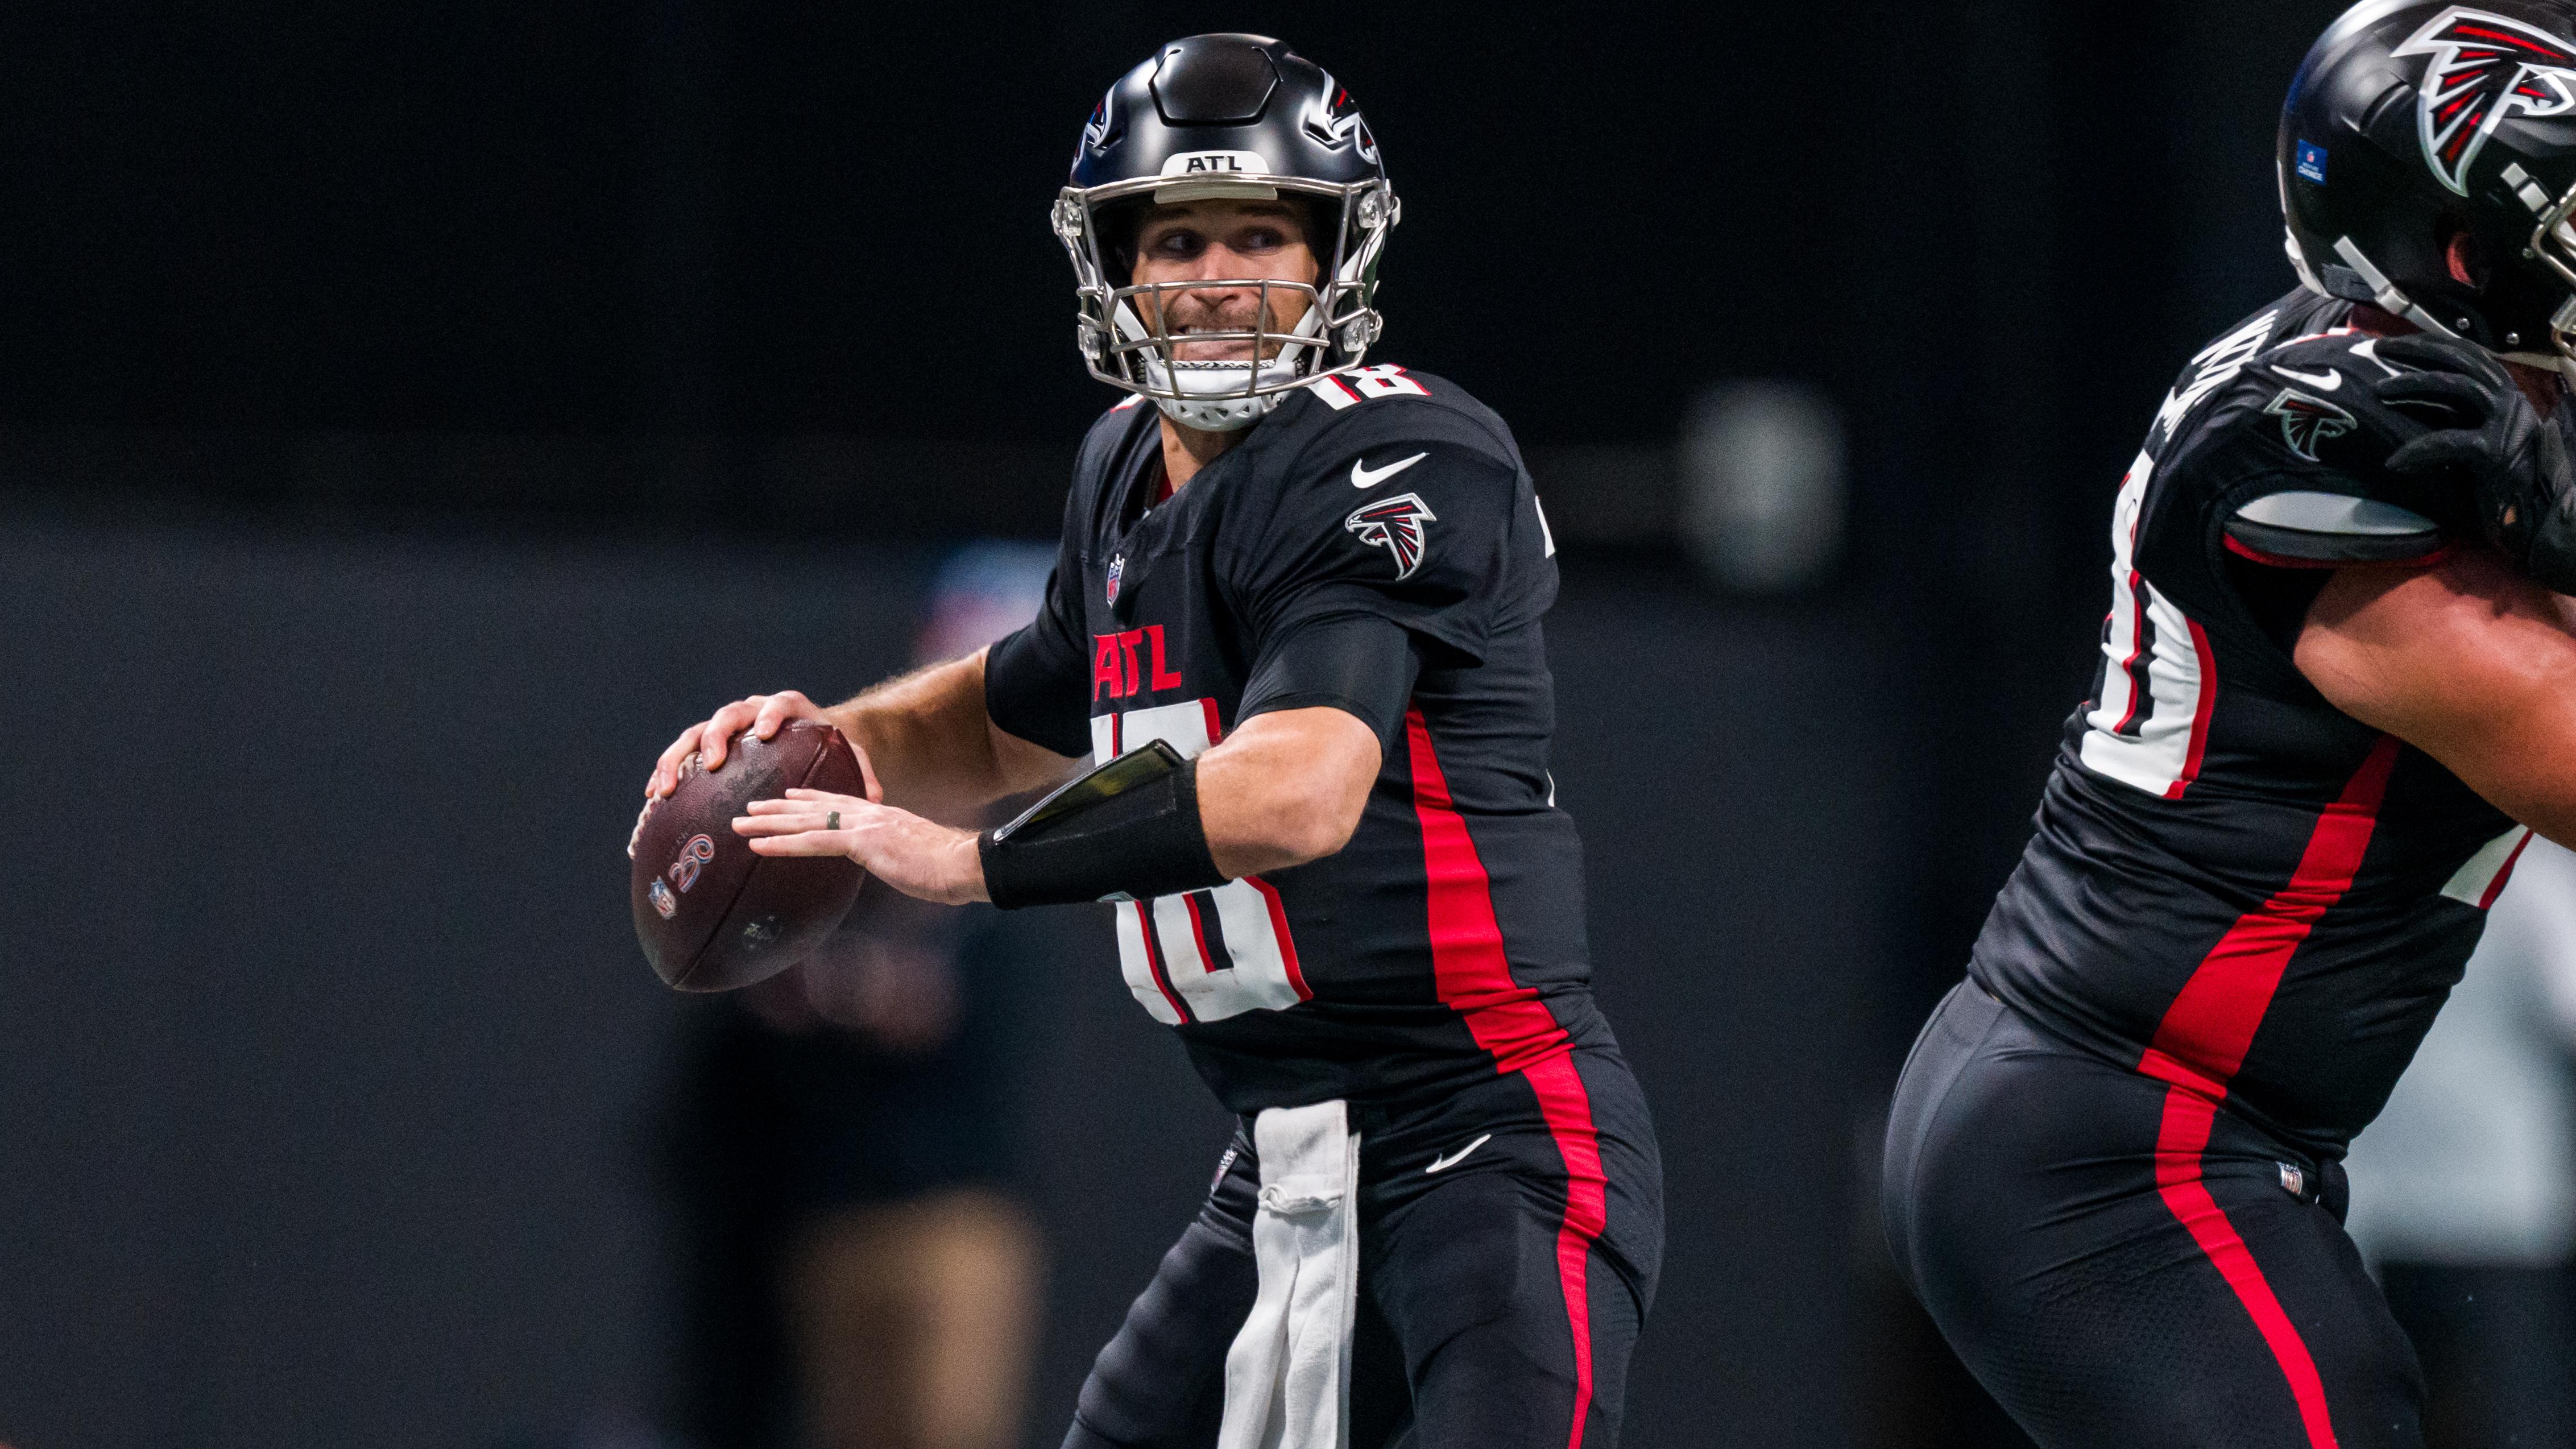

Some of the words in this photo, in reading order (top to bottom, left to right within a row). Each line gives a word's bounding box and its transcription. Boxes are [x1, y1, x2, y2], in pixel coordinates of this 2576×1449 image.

[1186, 155, 1243, 173] ATL
[1304, 363, 1432, 410] 18
[1094, 624, 1182, 701] ATL
